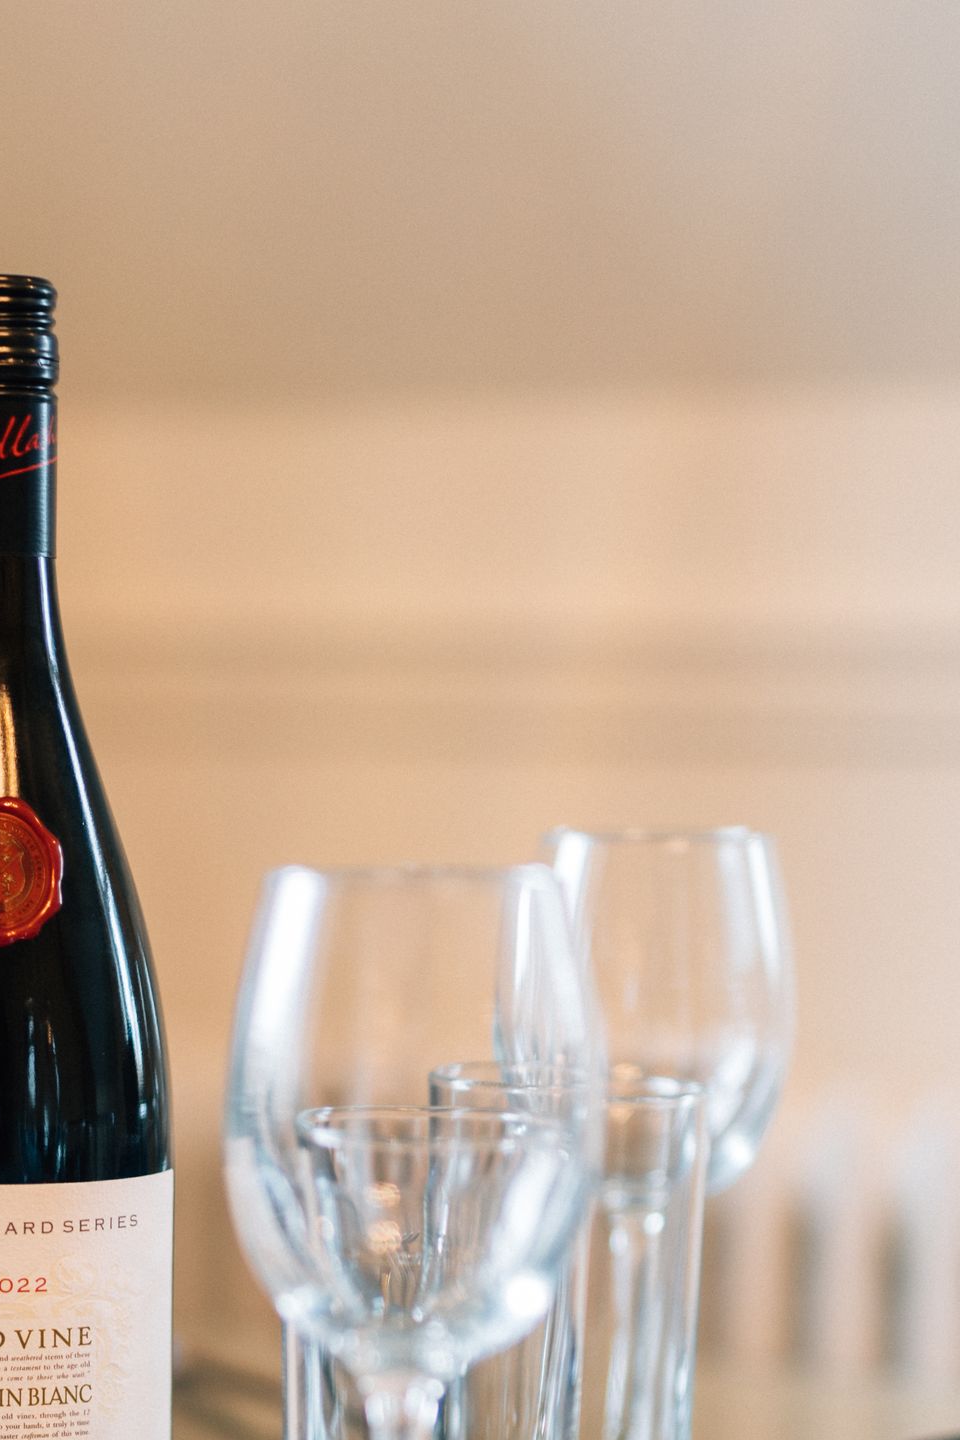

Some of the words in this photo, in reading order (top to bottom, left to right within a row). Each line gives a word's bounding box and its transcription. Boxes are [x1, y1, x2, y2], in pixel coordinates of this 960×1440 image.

[62, 1214, 138, 1233] SERIES
[14, 1326, 92, 1350] VINE
[28, 1384, 92, 1406] BLANC
[40, 1411, 66, 1420] through
[53, 1422, 68, 1430] truly
